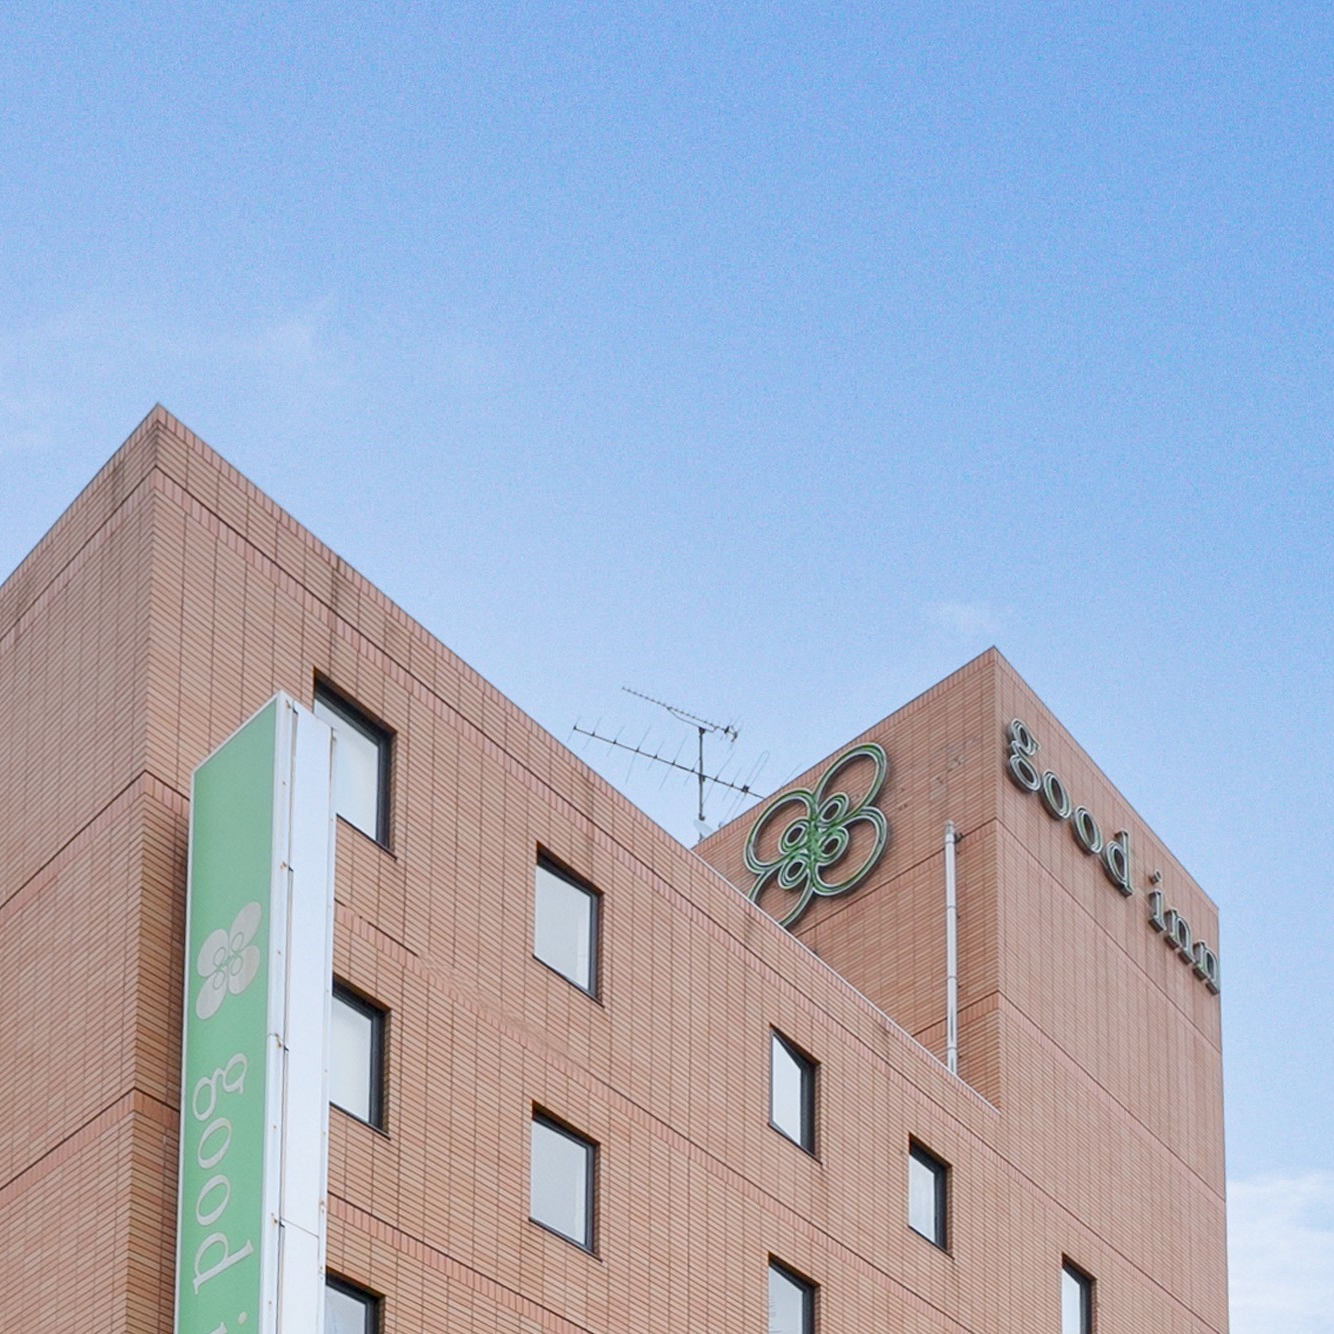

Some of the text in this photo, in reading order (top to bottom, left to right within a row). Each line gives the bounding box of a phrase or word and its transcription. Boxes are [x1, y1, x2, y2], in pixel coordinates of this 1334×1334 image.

[1006, 717, 1220, 996] good inn
[193, 1052, 255, 1295] good
